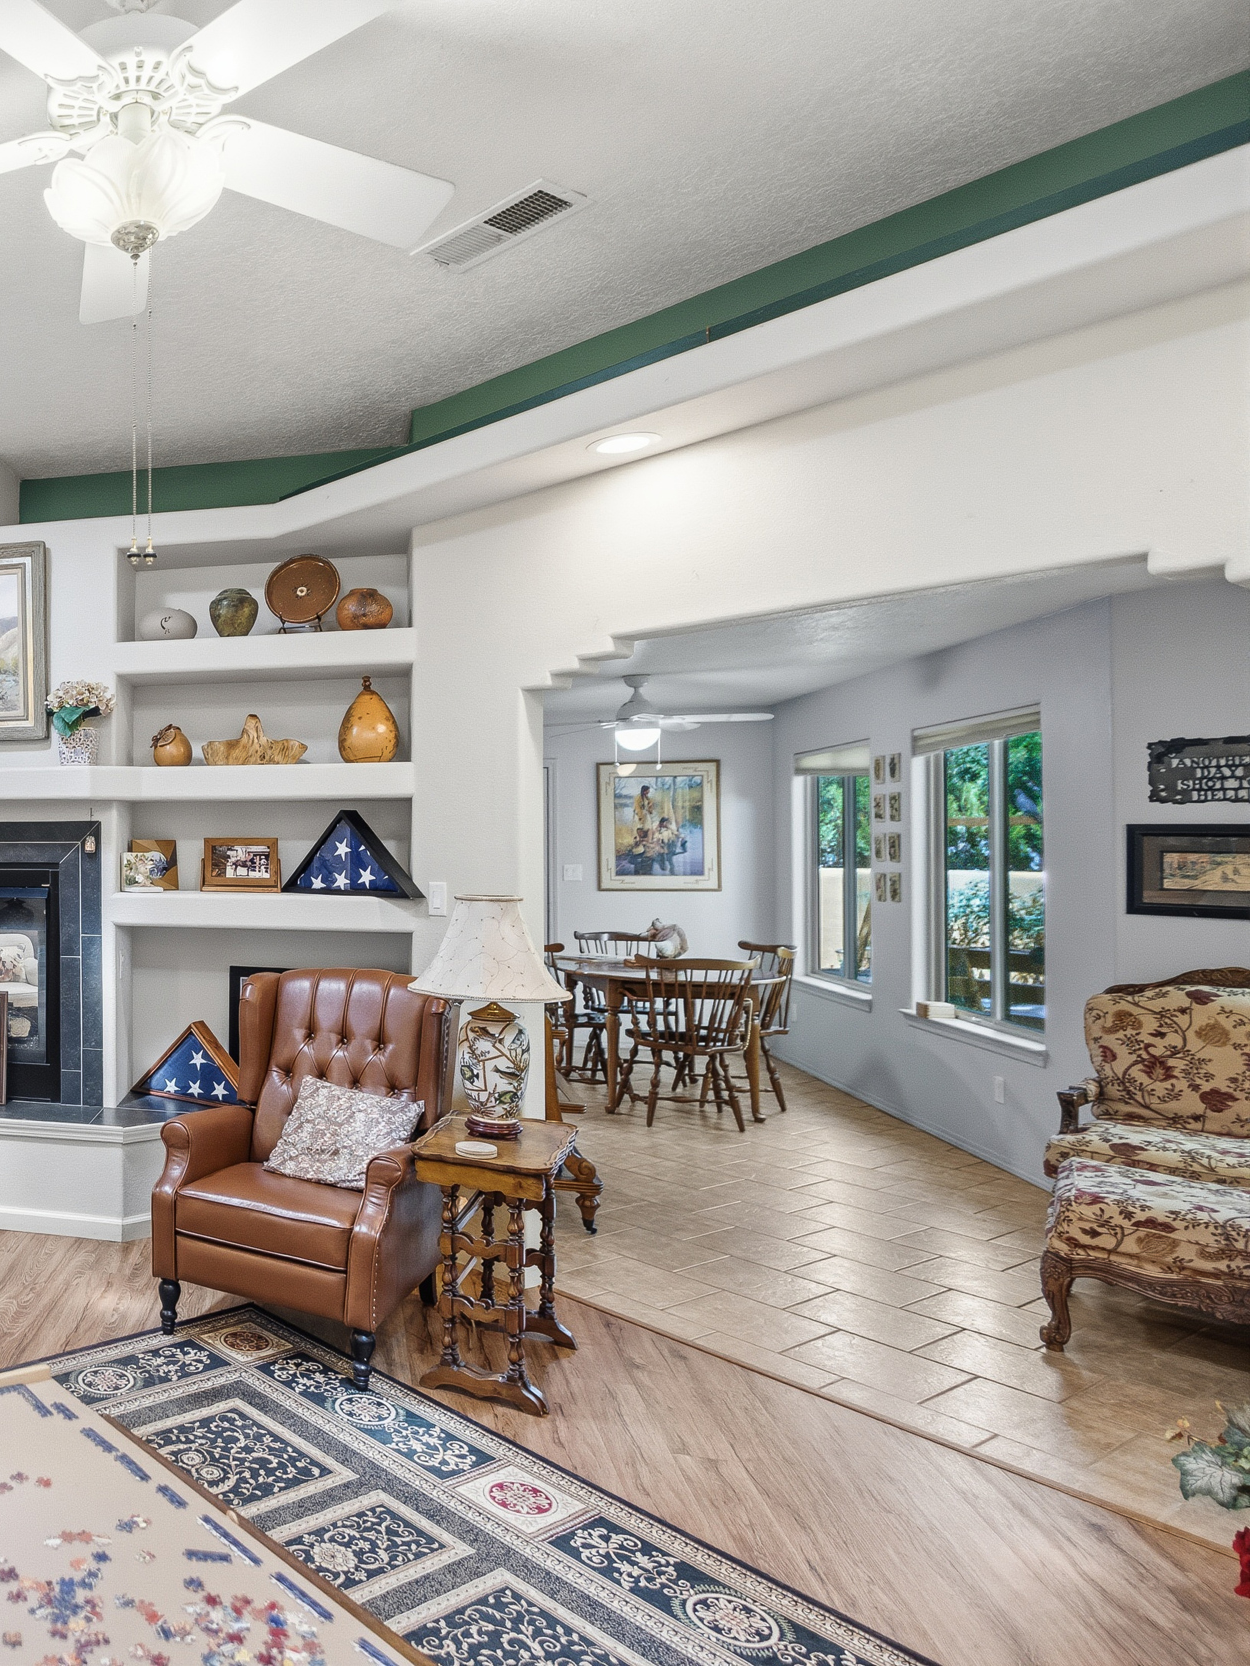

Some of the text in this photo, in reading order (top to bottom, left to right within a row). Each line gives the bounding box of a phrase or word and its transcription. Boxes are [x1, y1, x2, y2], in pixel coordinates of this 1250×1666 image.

[1174, 756, 1250, 768] ANOTHE
[1200, 767, 1242, 778] DAY
[1180, 779, 1228, 790] SHOT
[1197, 790, 1247, 801] HELL
